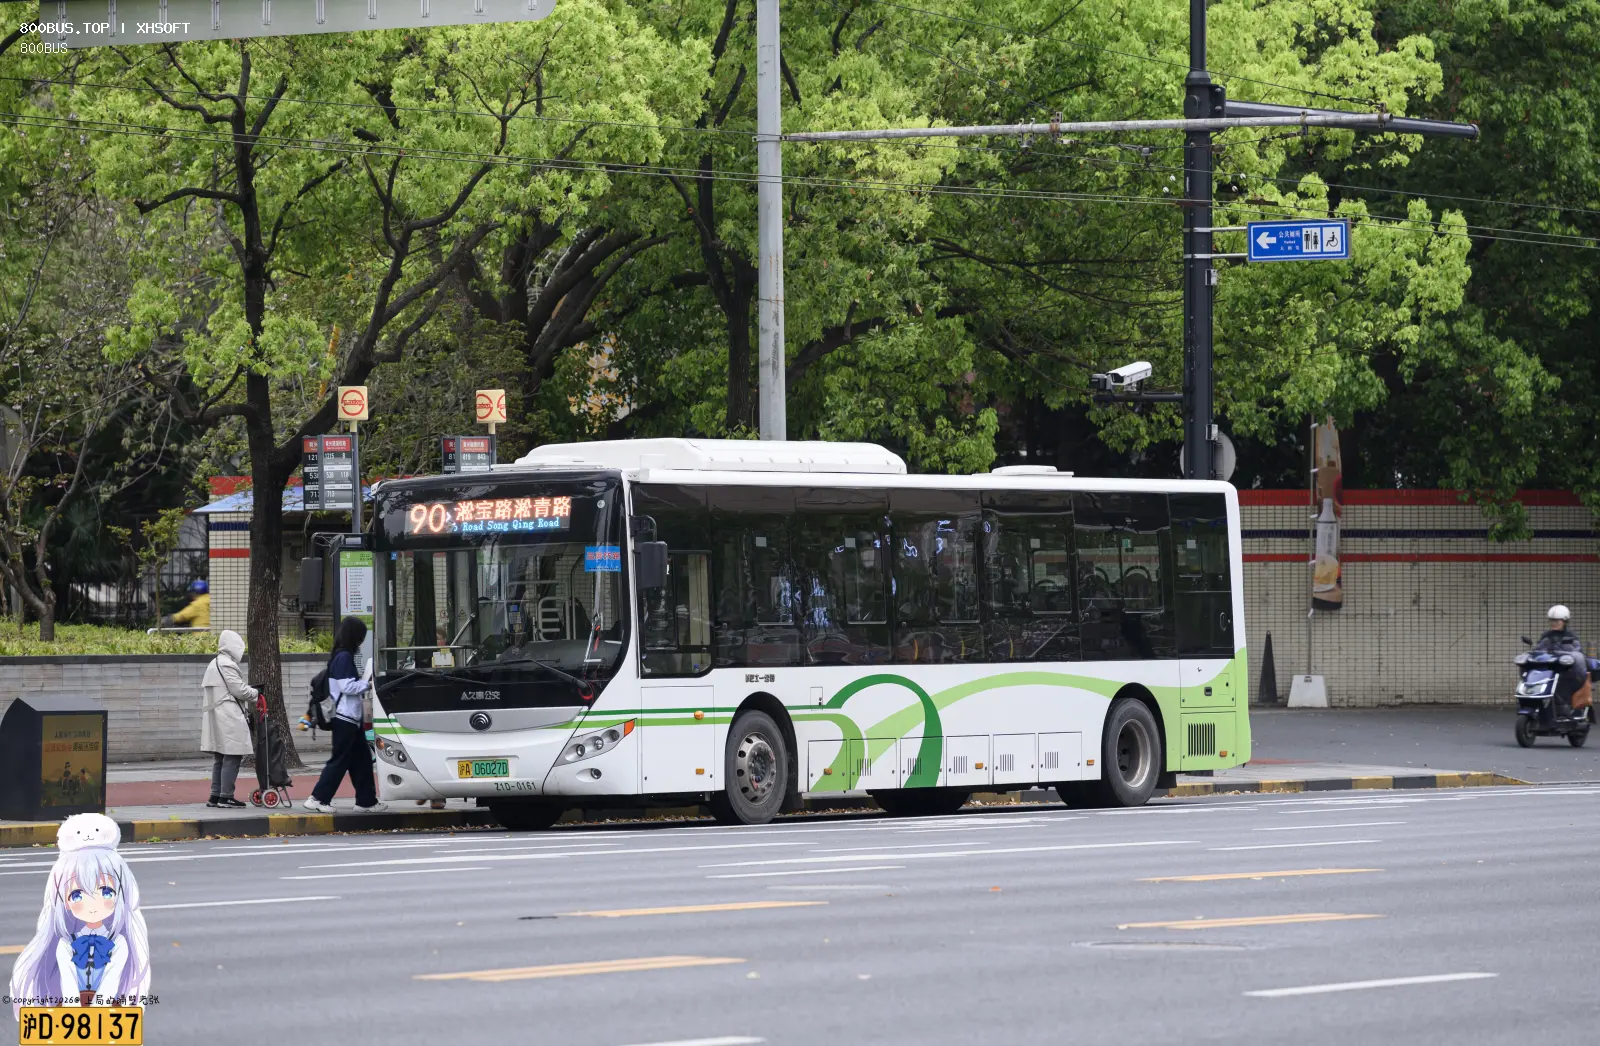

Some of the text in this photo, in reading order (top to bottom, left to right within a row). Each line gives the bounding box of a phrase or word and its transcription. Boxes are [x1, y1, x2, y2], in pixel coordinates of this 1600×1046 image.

[326, 490, 336, 498] 713
[454, 497, 571, 521] 淞宝路淞青路
[410, 503, 446, 534] 90
[462, 521, 483, 531] Road
[487, 520, 508, 533] Song
[512, 519, 534, 530] Qing
[537, 517, 560, 528] Road
[468, 690, 501, 701] 久事公交
[474, 761, 508, 775] 06027D
[494, 781, 537, 791] Z1D-0161
